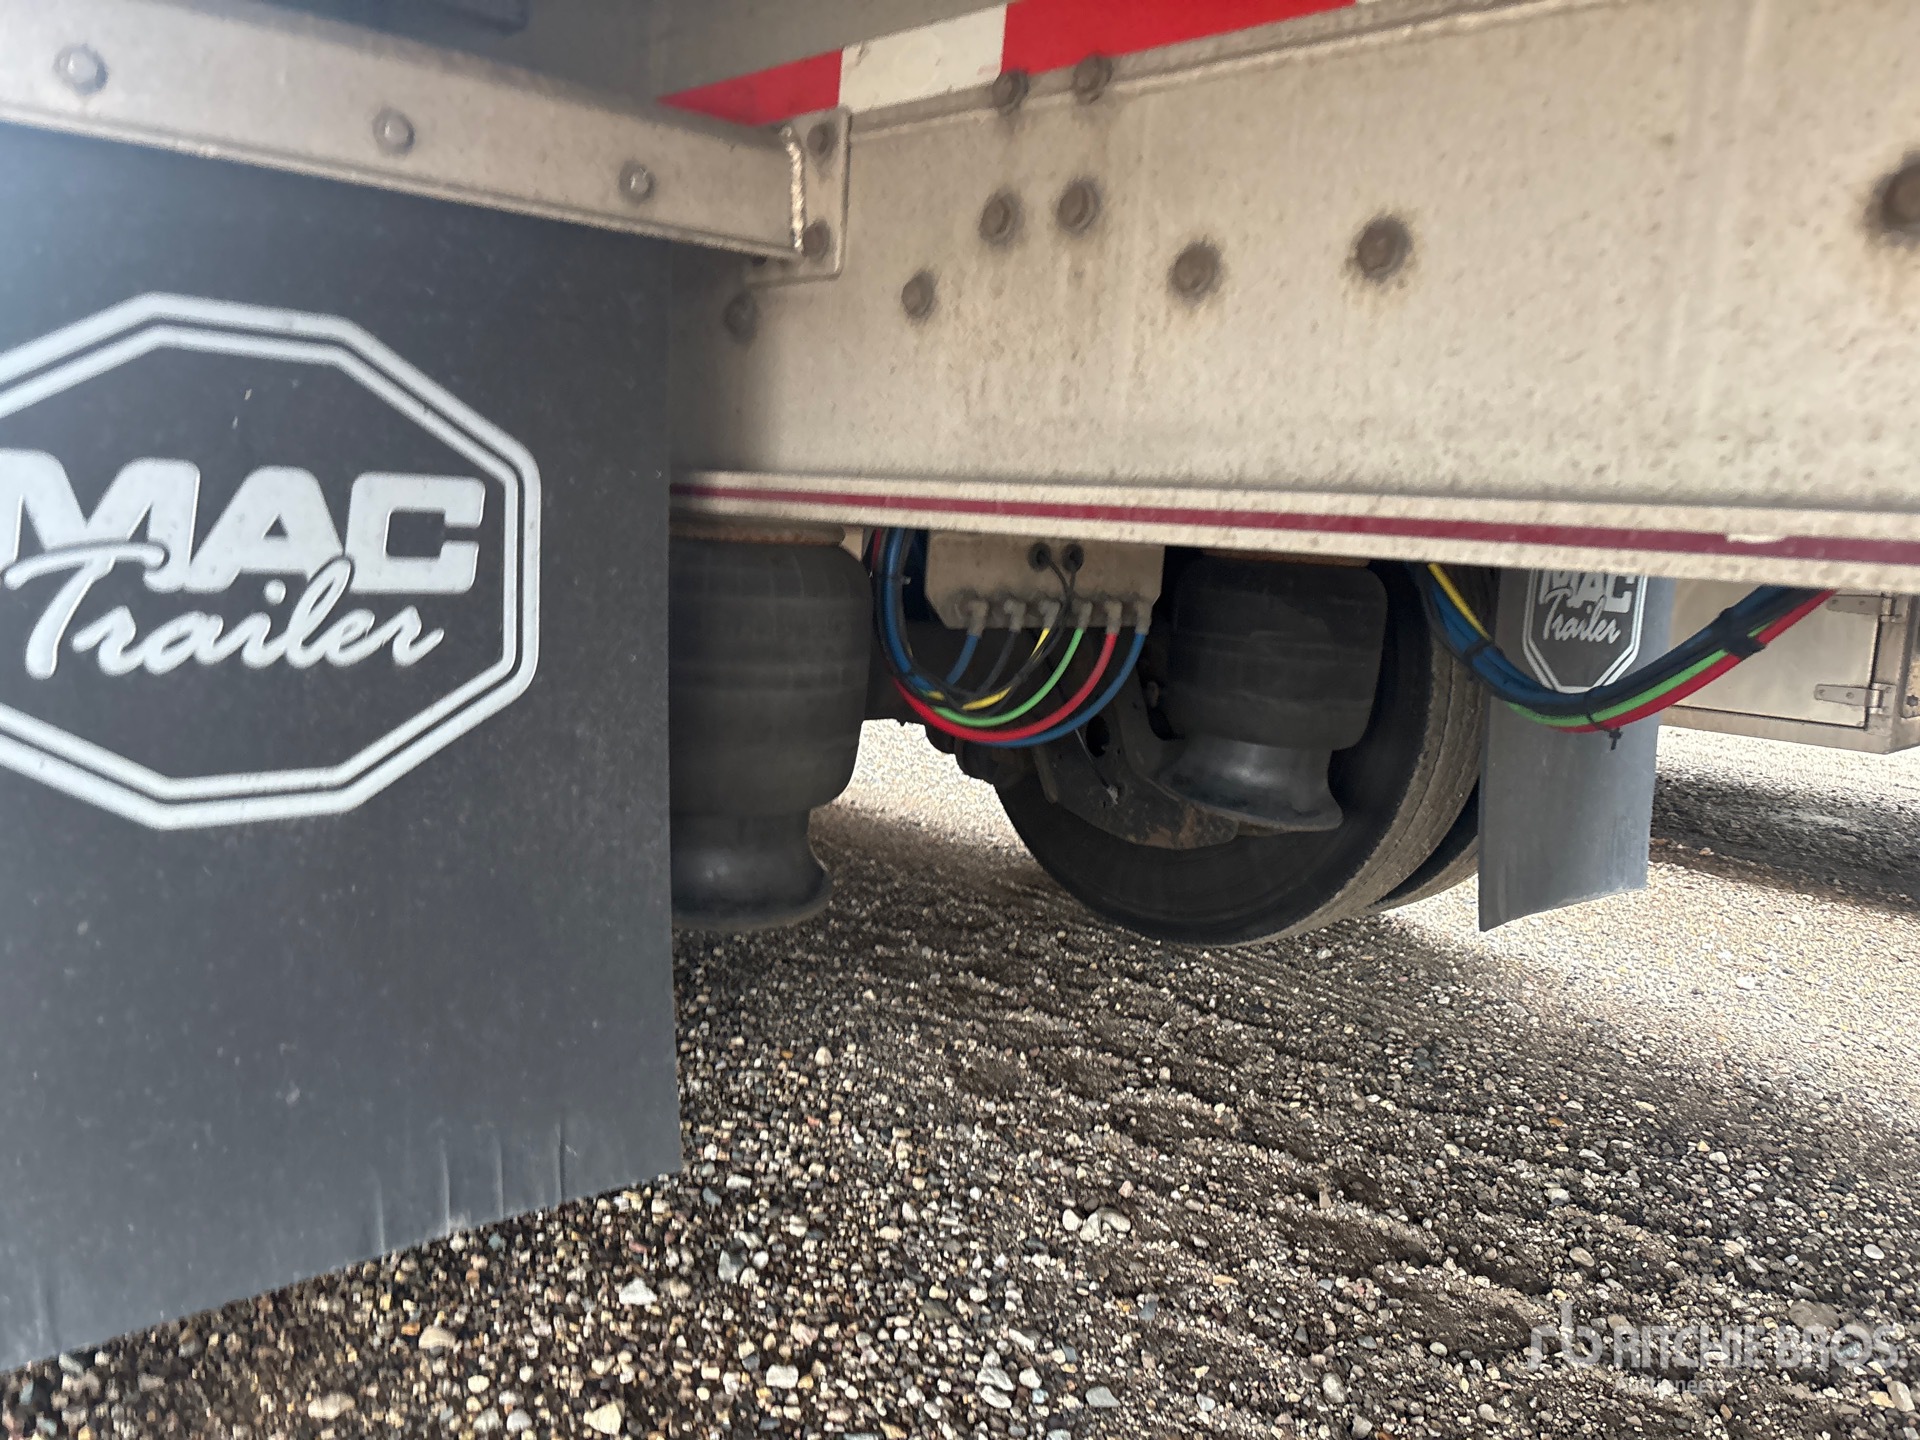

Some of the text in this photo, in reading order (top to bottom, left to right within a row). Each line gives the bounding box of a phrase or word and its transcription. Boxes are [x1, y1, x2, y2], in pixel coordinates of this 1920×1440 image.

[0, 448, 486, 593] MAC
[4, 541, 444, 680] Trailer
[1538, 570, 1635, 614] MAC
[1543, 586, 1621, 644] Trailer
